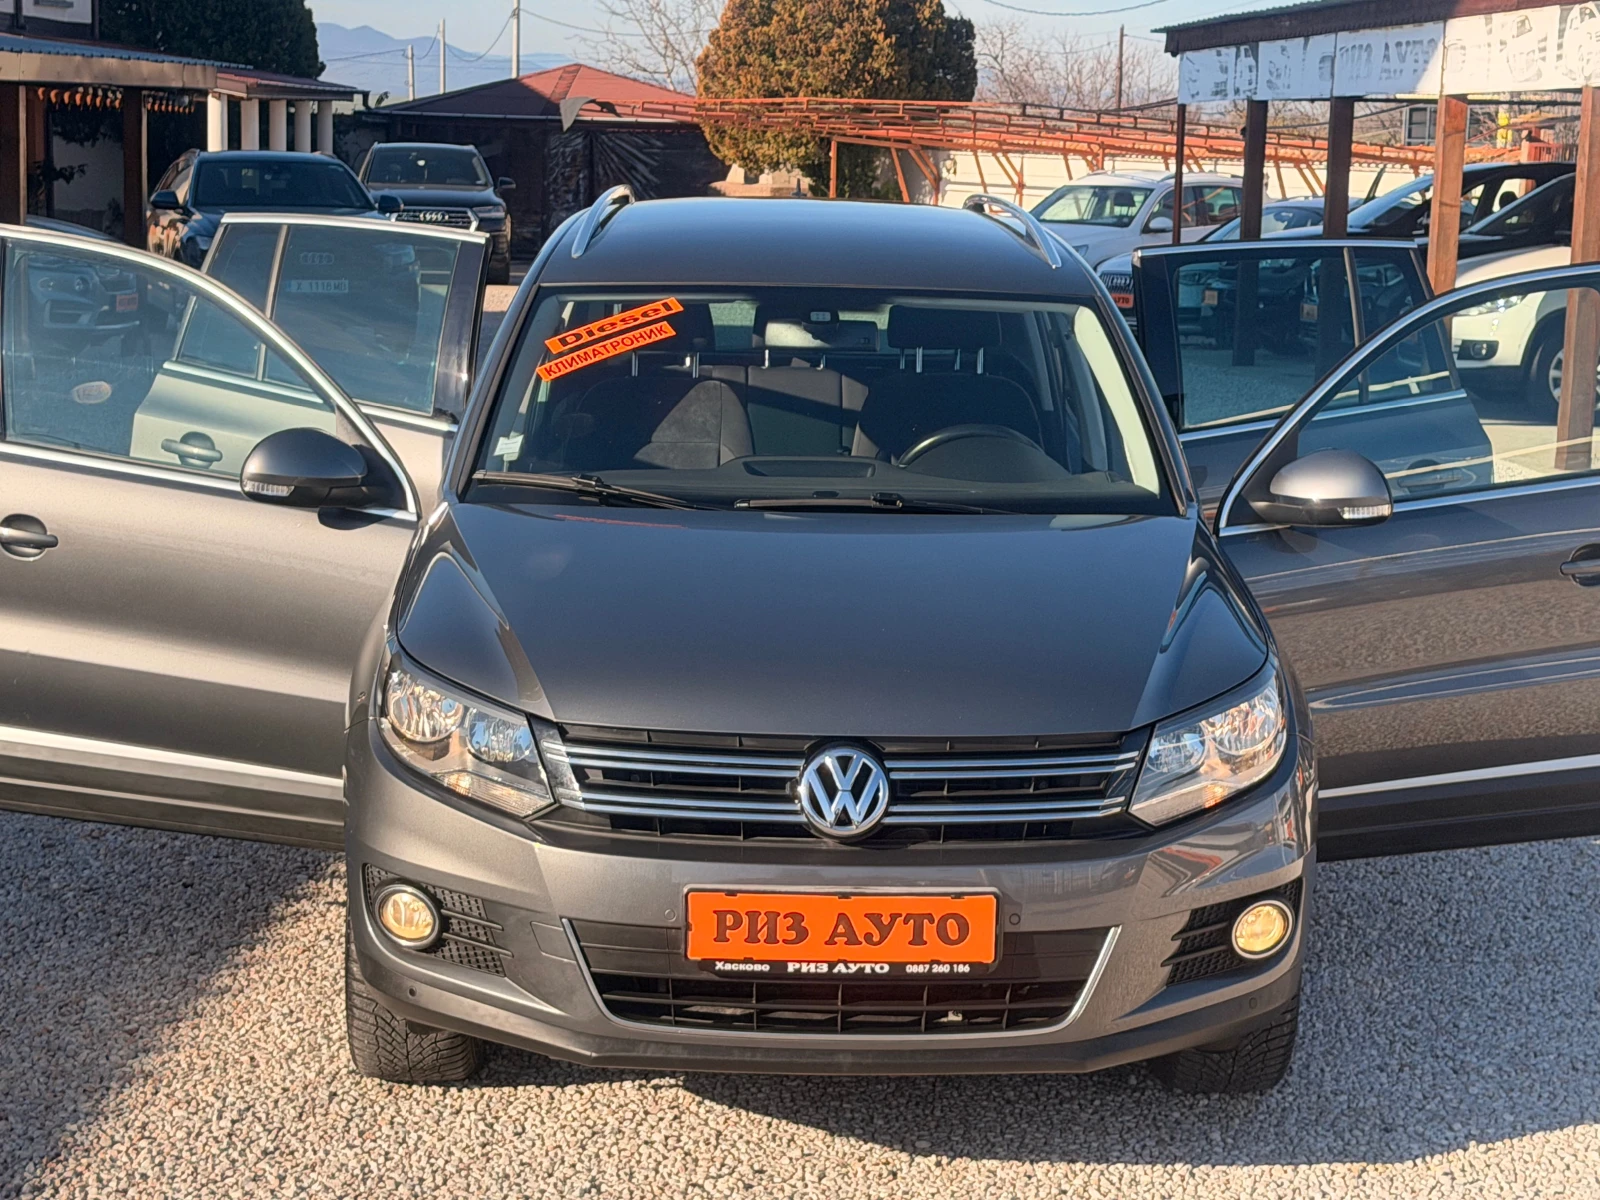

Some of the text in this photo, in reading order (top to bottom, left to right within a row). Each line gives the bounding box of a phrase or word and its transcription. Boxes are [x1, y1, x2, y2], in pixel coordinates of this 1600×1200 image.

[557, 301, 673, 347] Diesel
[544, 325, 668, 376] КЛИМАТРОНИК
[713, 910, 970, 946] РИЗ АУТО
[715, 961, 970, 974] Хасково РИЗ АУТО 0887 260 186
